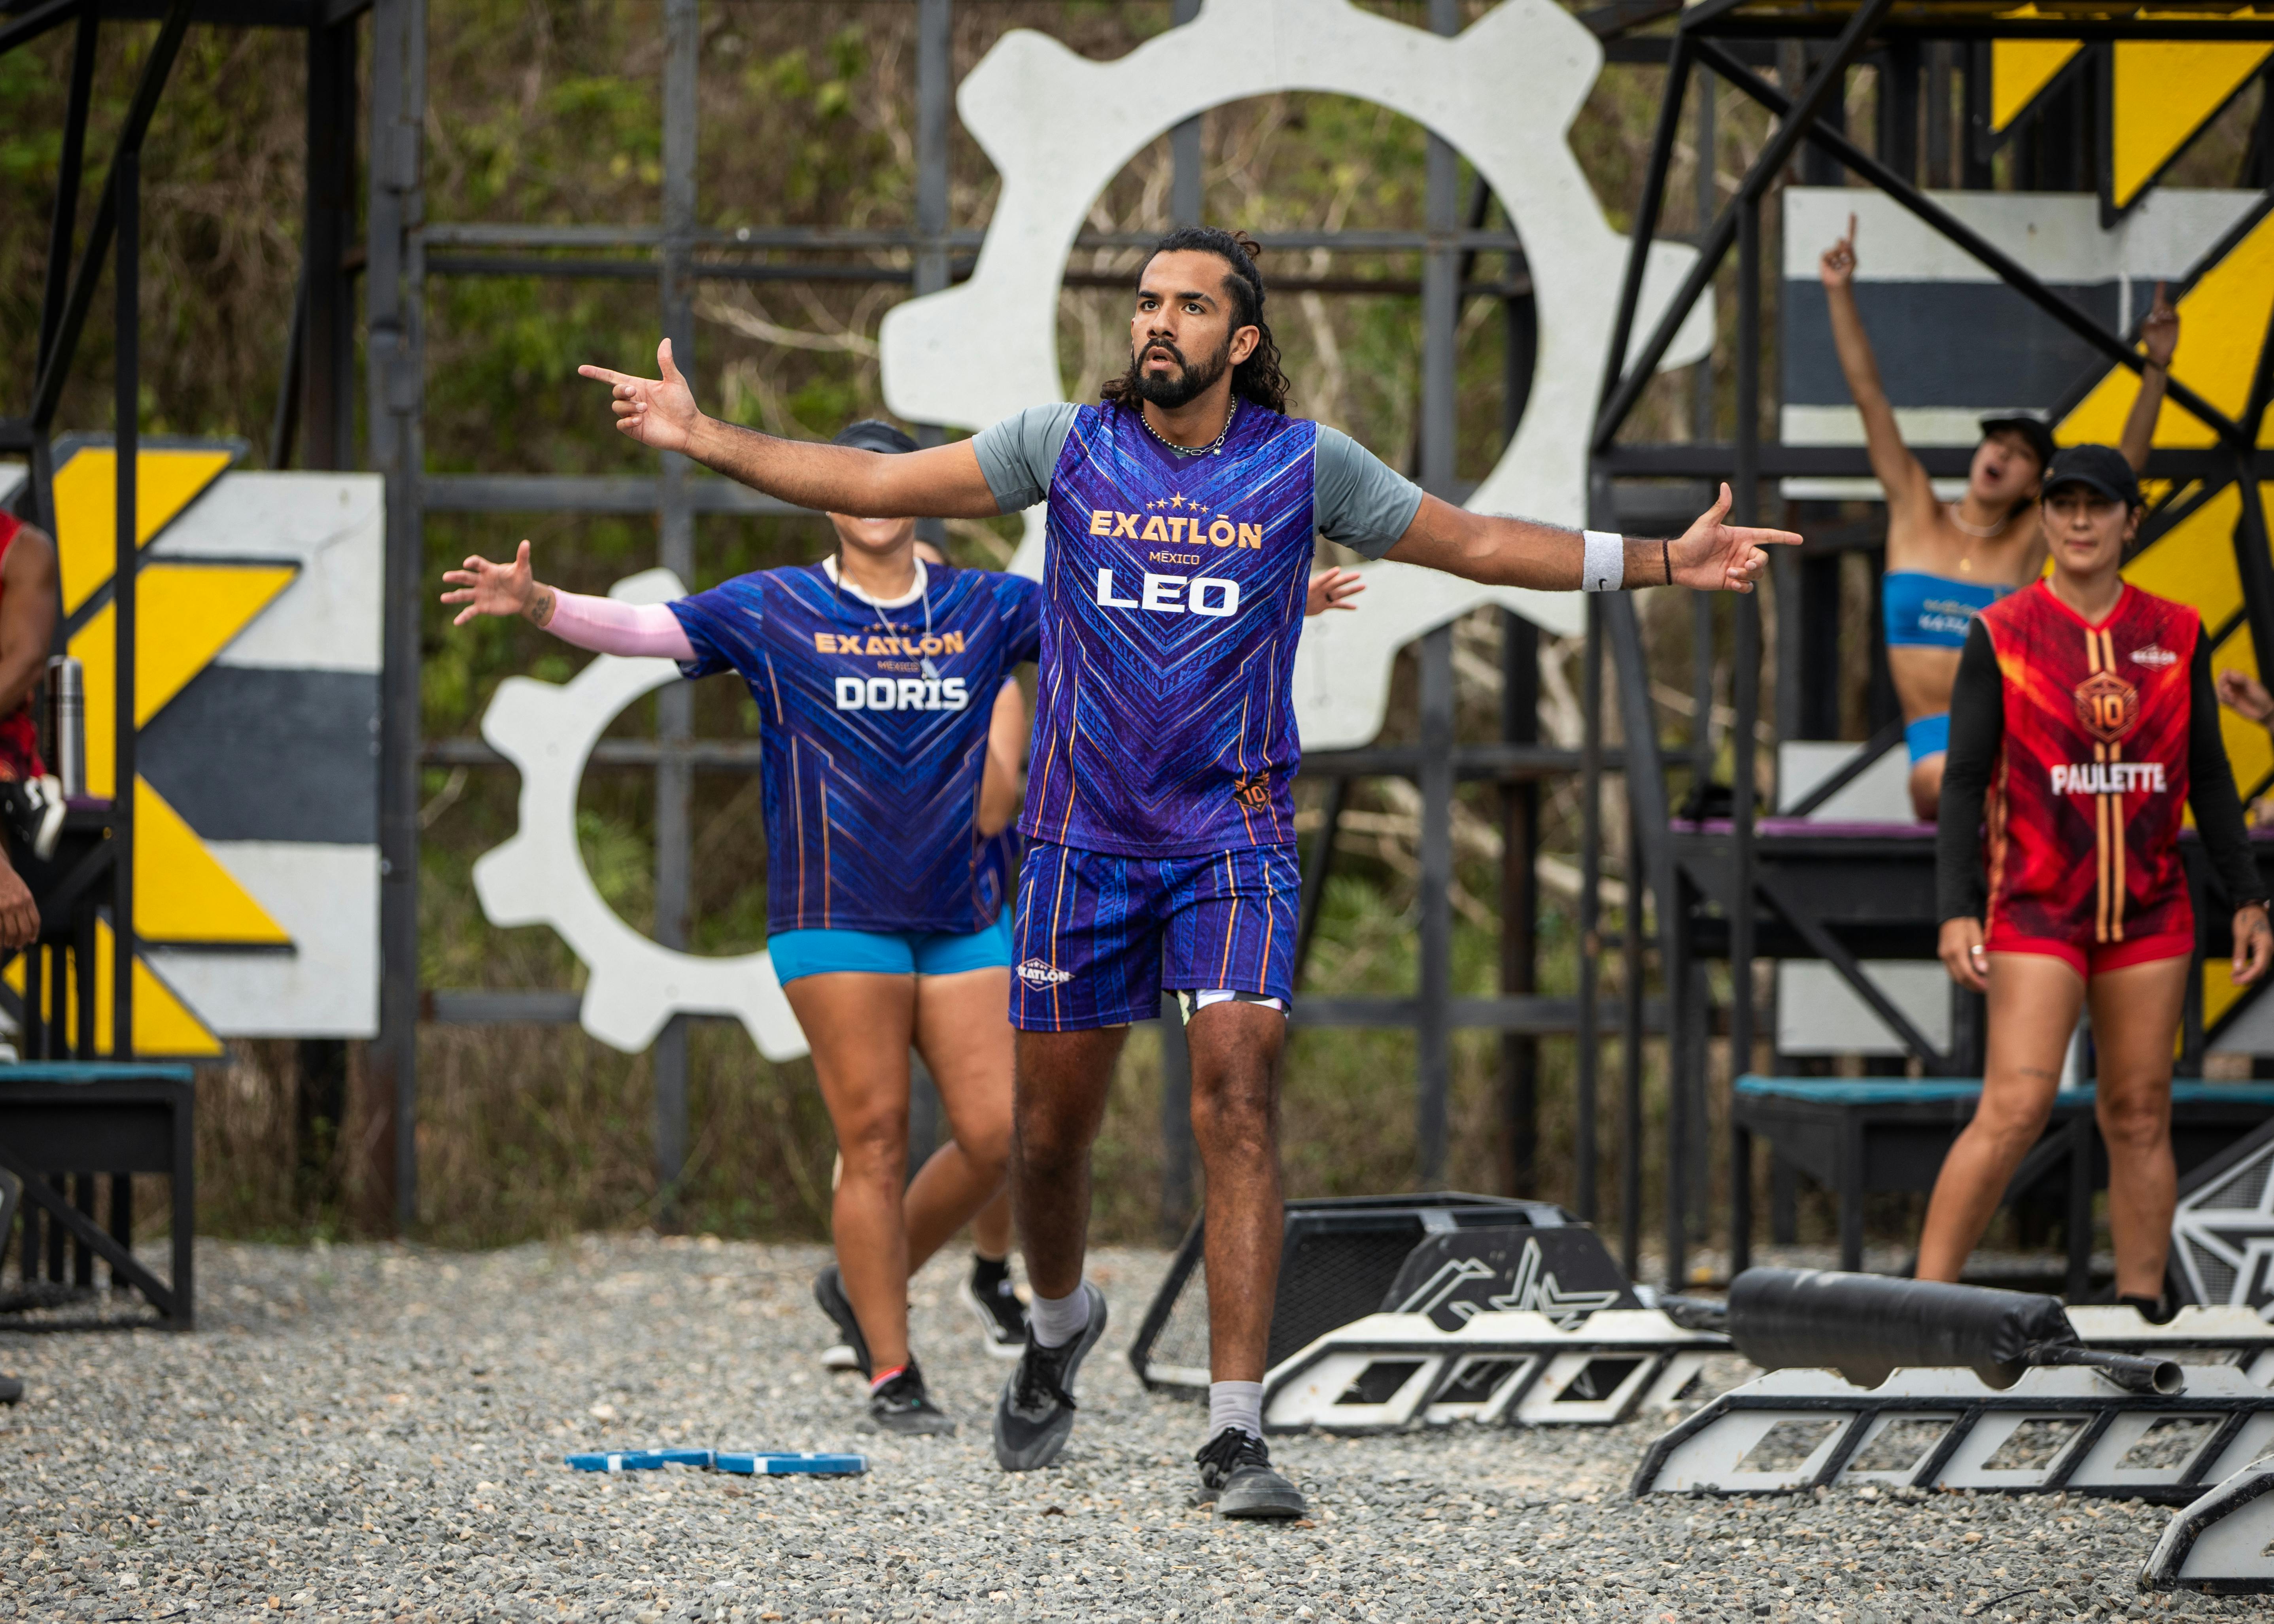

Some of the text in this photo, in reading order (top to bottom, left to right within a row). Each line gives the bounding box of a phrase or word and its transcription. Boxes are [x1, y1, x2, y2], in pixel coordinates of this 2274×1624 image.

[1097, 568, 1240, 617] LEO
[835, 677, 970, 711] DORIS
[2091, 694, 2124, 728] 10
[1244, 786, 1266, 805] 10
[2051, 762, 2167, 796] PAULETTE
